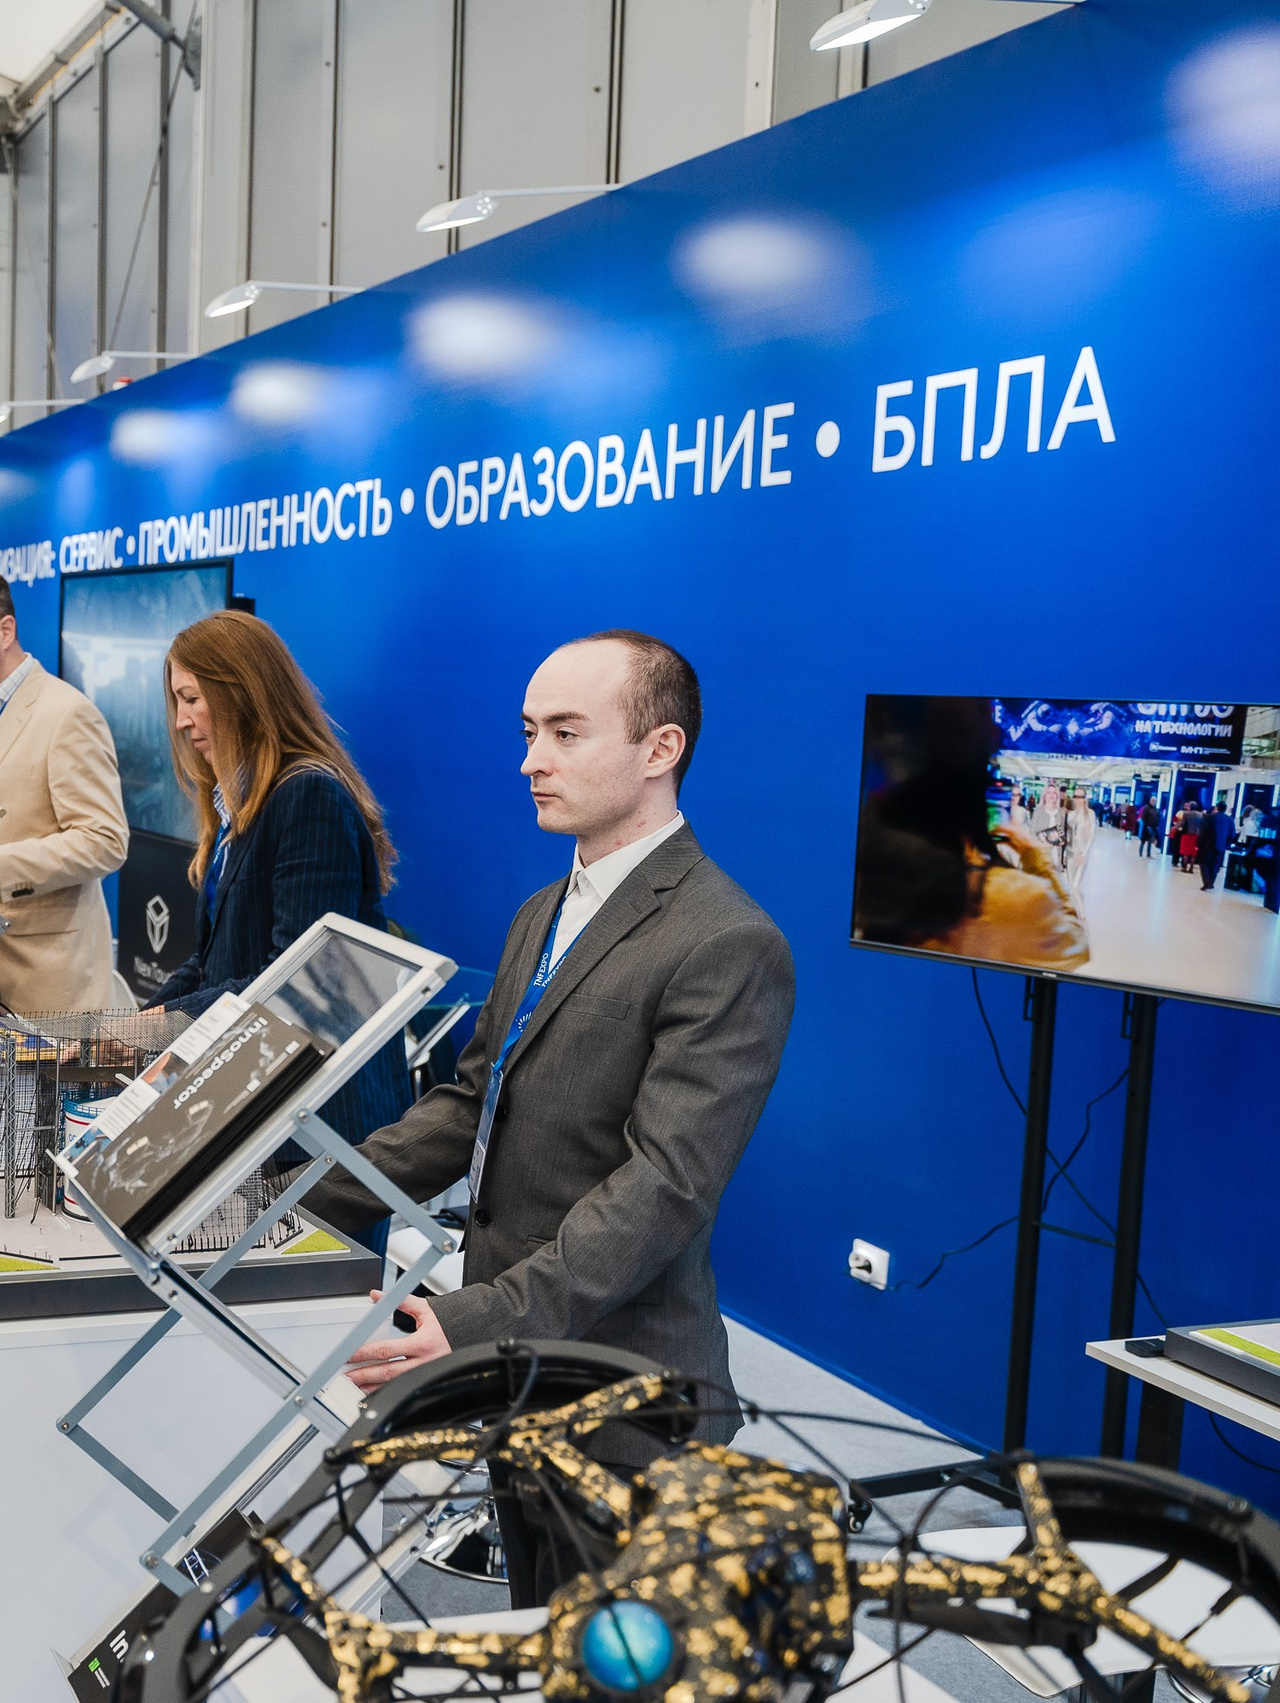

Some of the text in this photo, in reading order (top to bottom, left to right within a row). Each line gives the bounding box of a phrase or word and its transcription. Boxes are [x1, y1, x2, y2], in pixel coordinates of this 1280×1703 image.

[59, 526, 124, 573] СЕРВИС
[138, 478, 393, 565] ПРОМЫШЛЕННОСТЬ
[425, 402, 795, 529] ОБРАЗОВАНИЕ
[872, 346, 1116, 473] БПЛА
[173, 1016, 269, 1110] InnoSpector
